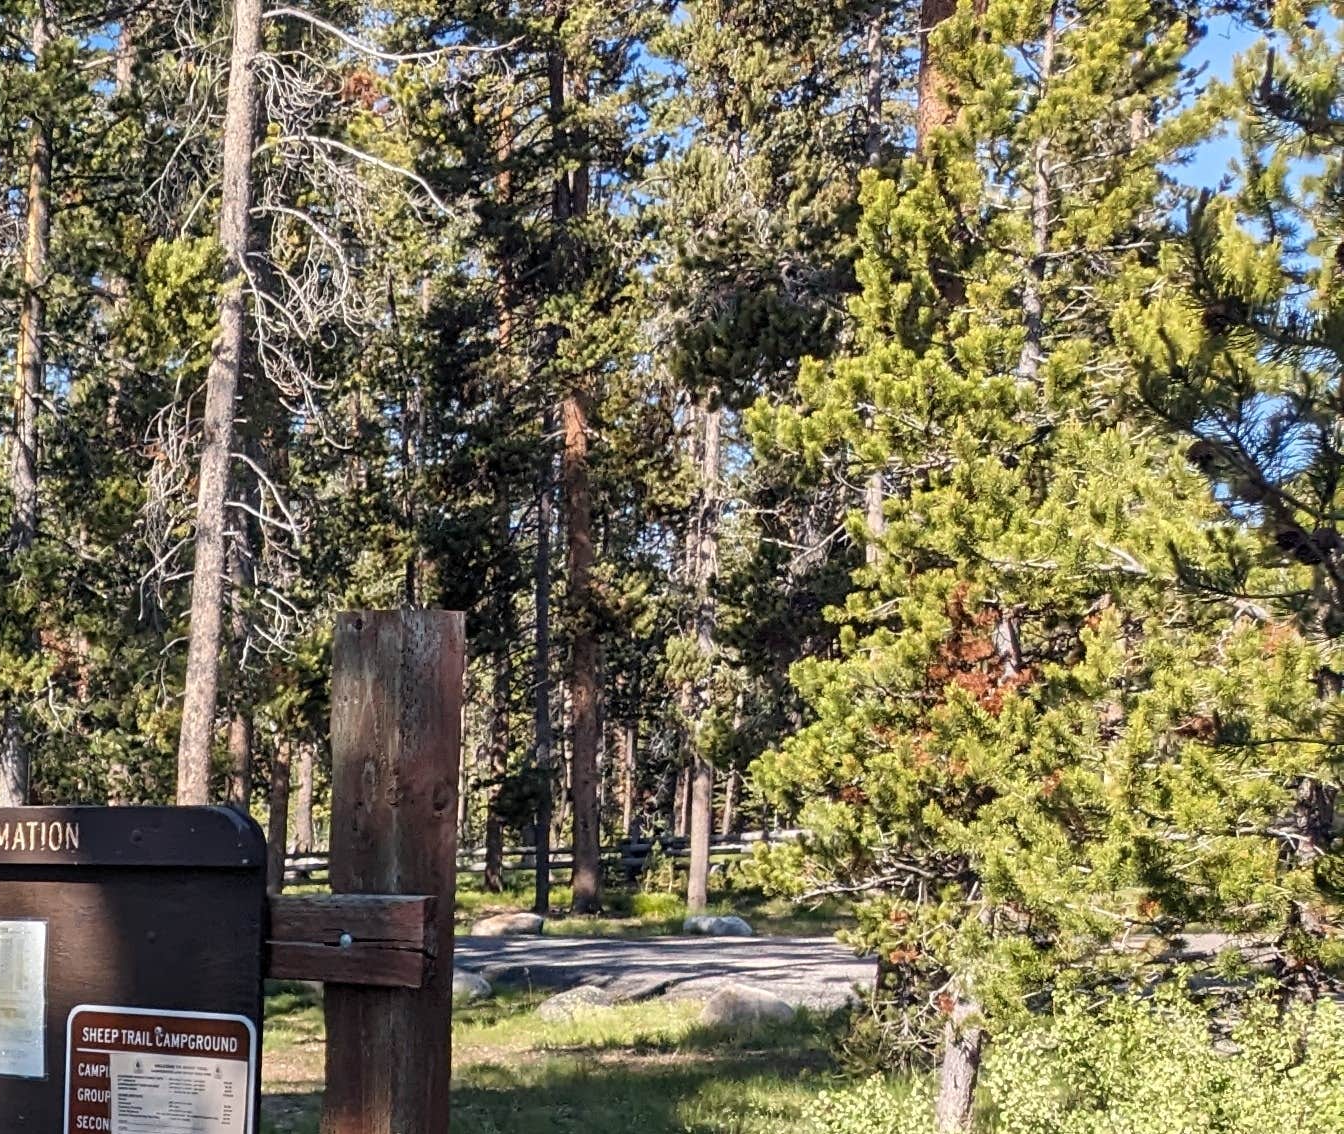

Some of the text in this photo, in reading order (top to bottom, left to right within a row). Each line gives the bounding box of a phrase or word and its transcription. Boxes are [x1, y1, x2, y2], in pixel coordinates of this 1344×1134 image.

[82, 1027, 238, 1053] SHEEP TRAIL CAMPGROUND
[78, 1062, 110, 1078] CAMPI
[77, 1088, 111, 1103] GROUP
[76, 1115, 111, 1131] SECON
